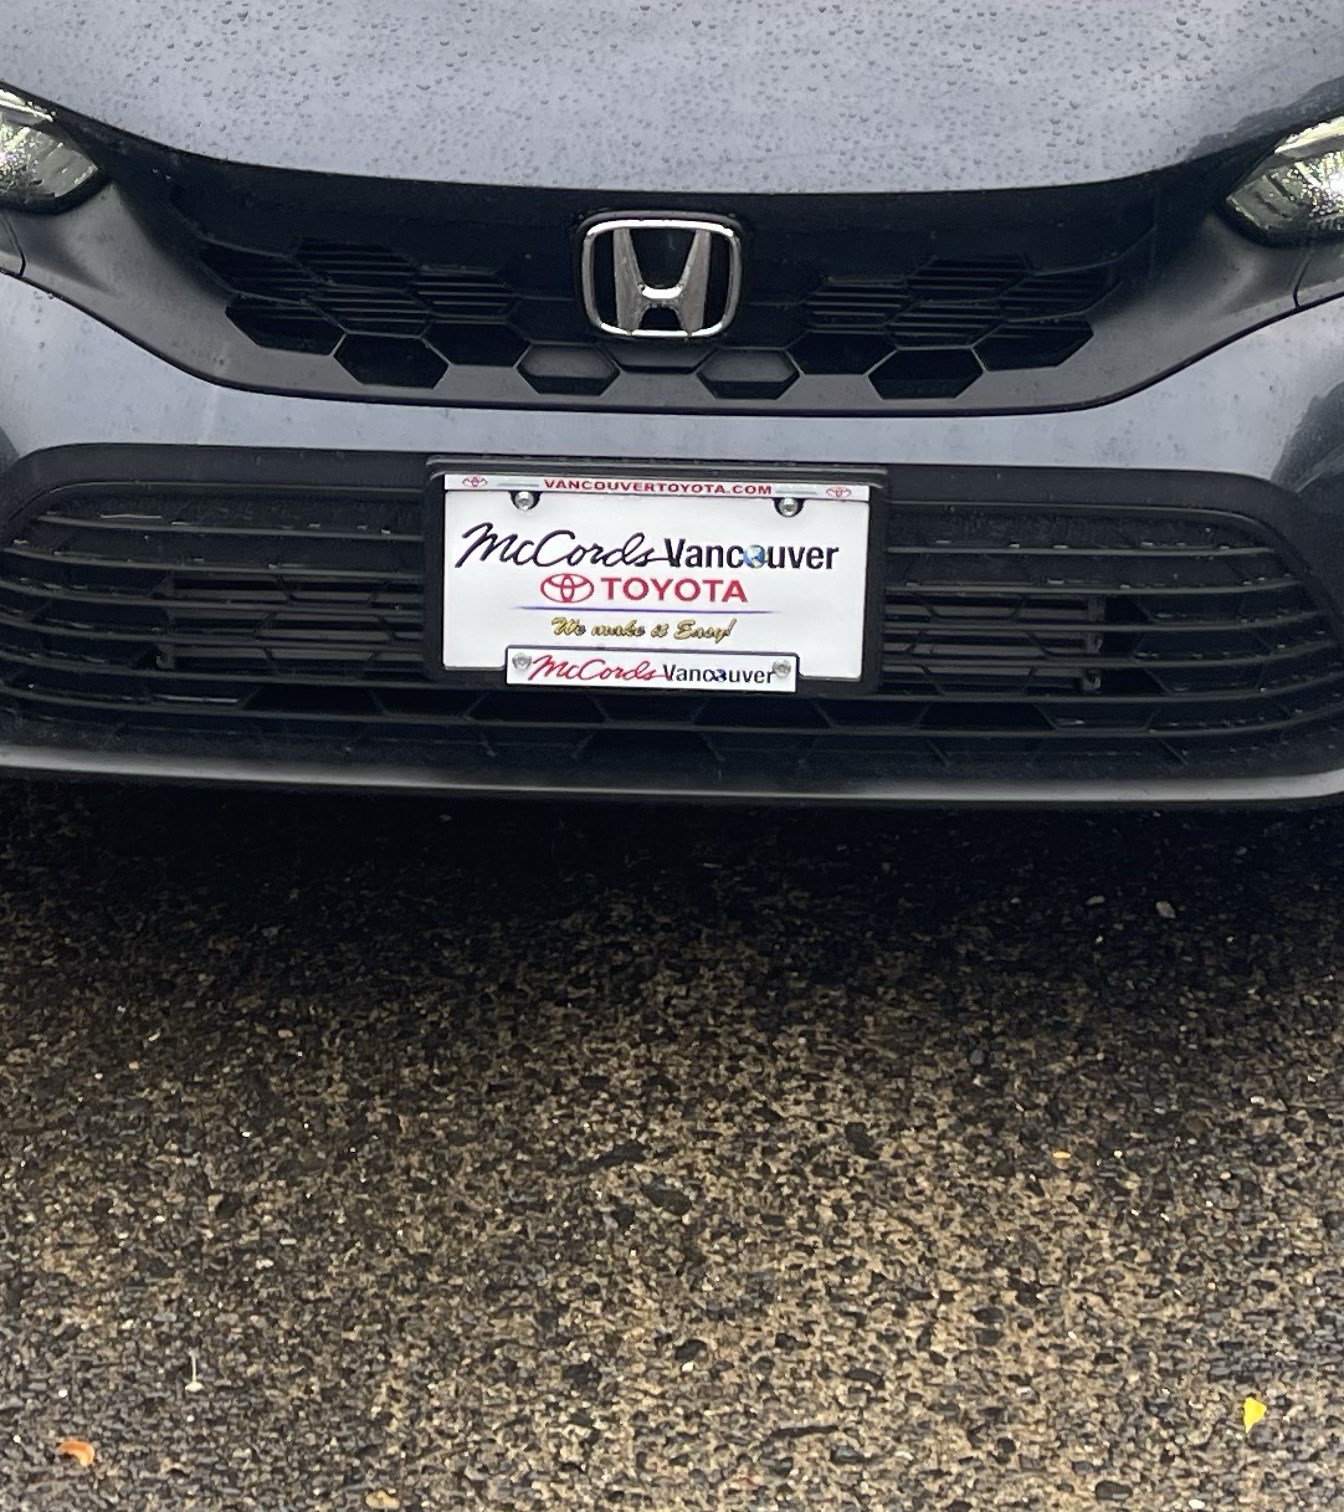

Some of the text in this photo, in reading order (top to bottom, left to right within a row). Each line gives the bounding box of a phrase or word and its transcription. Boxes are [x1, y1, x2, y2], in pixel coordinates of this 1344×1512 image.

[544, 479, 773, 495] VANCOUVERTOYOTA.COM
[454, 522, 840, 571] McCords Vancouver
[600, 576, 749, 603] TOYOTA
[551, 616, 738, 644] We make it Easy!
[527, 653, 775, 685] McCords Vancouver
